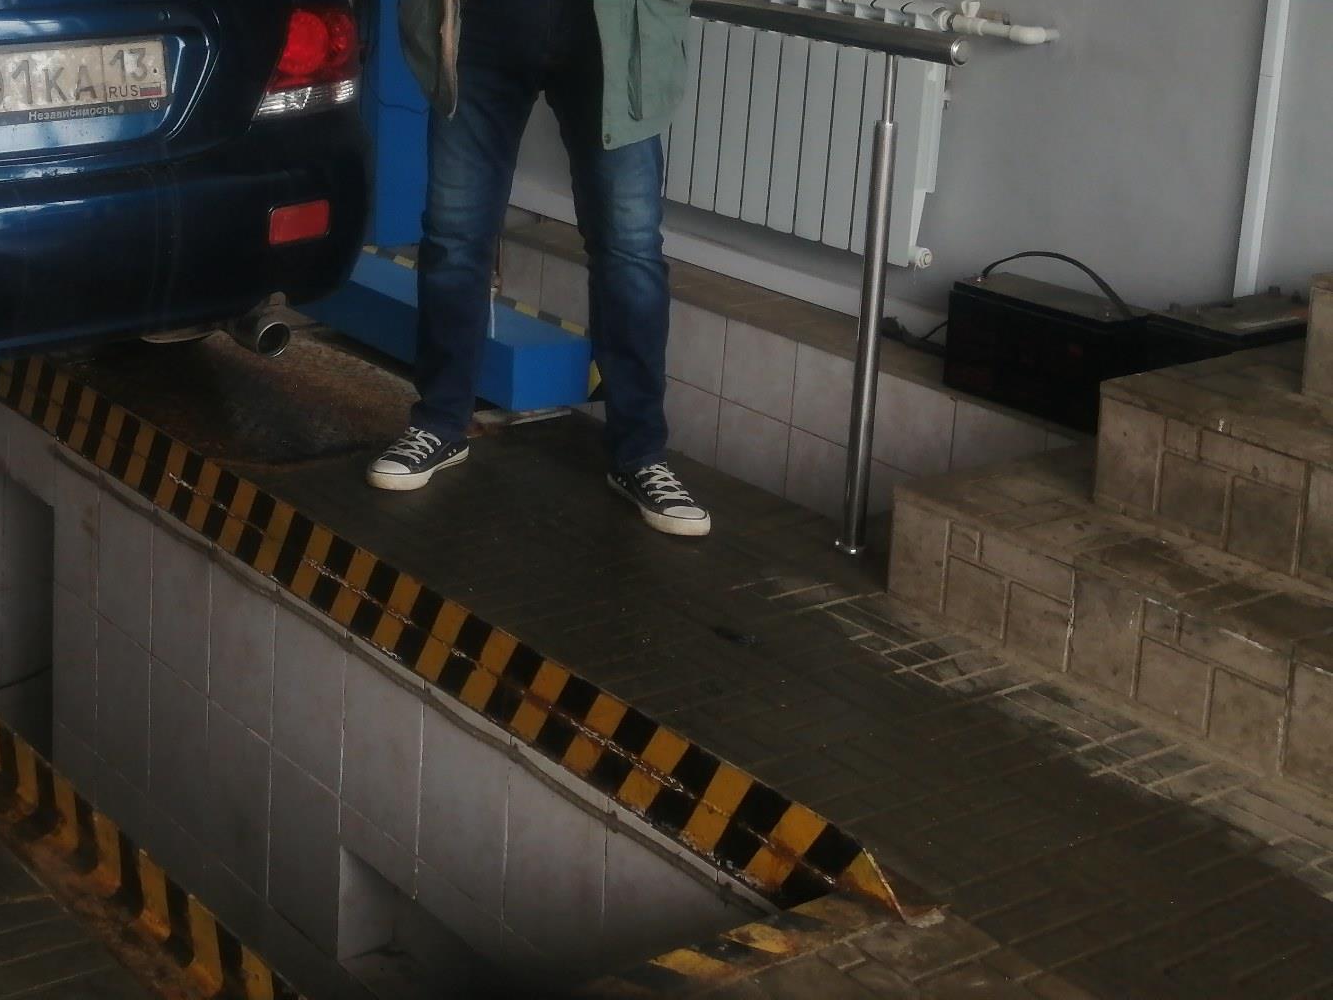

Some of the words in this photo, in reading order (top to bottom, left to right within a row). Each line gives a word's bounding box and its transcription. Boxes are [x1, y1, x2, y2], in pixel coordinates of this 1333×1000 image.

[109, 47, 148, 83] 13
[108, 85, 139, 99] RUS
[28, 106, 115, 121] Независимость
